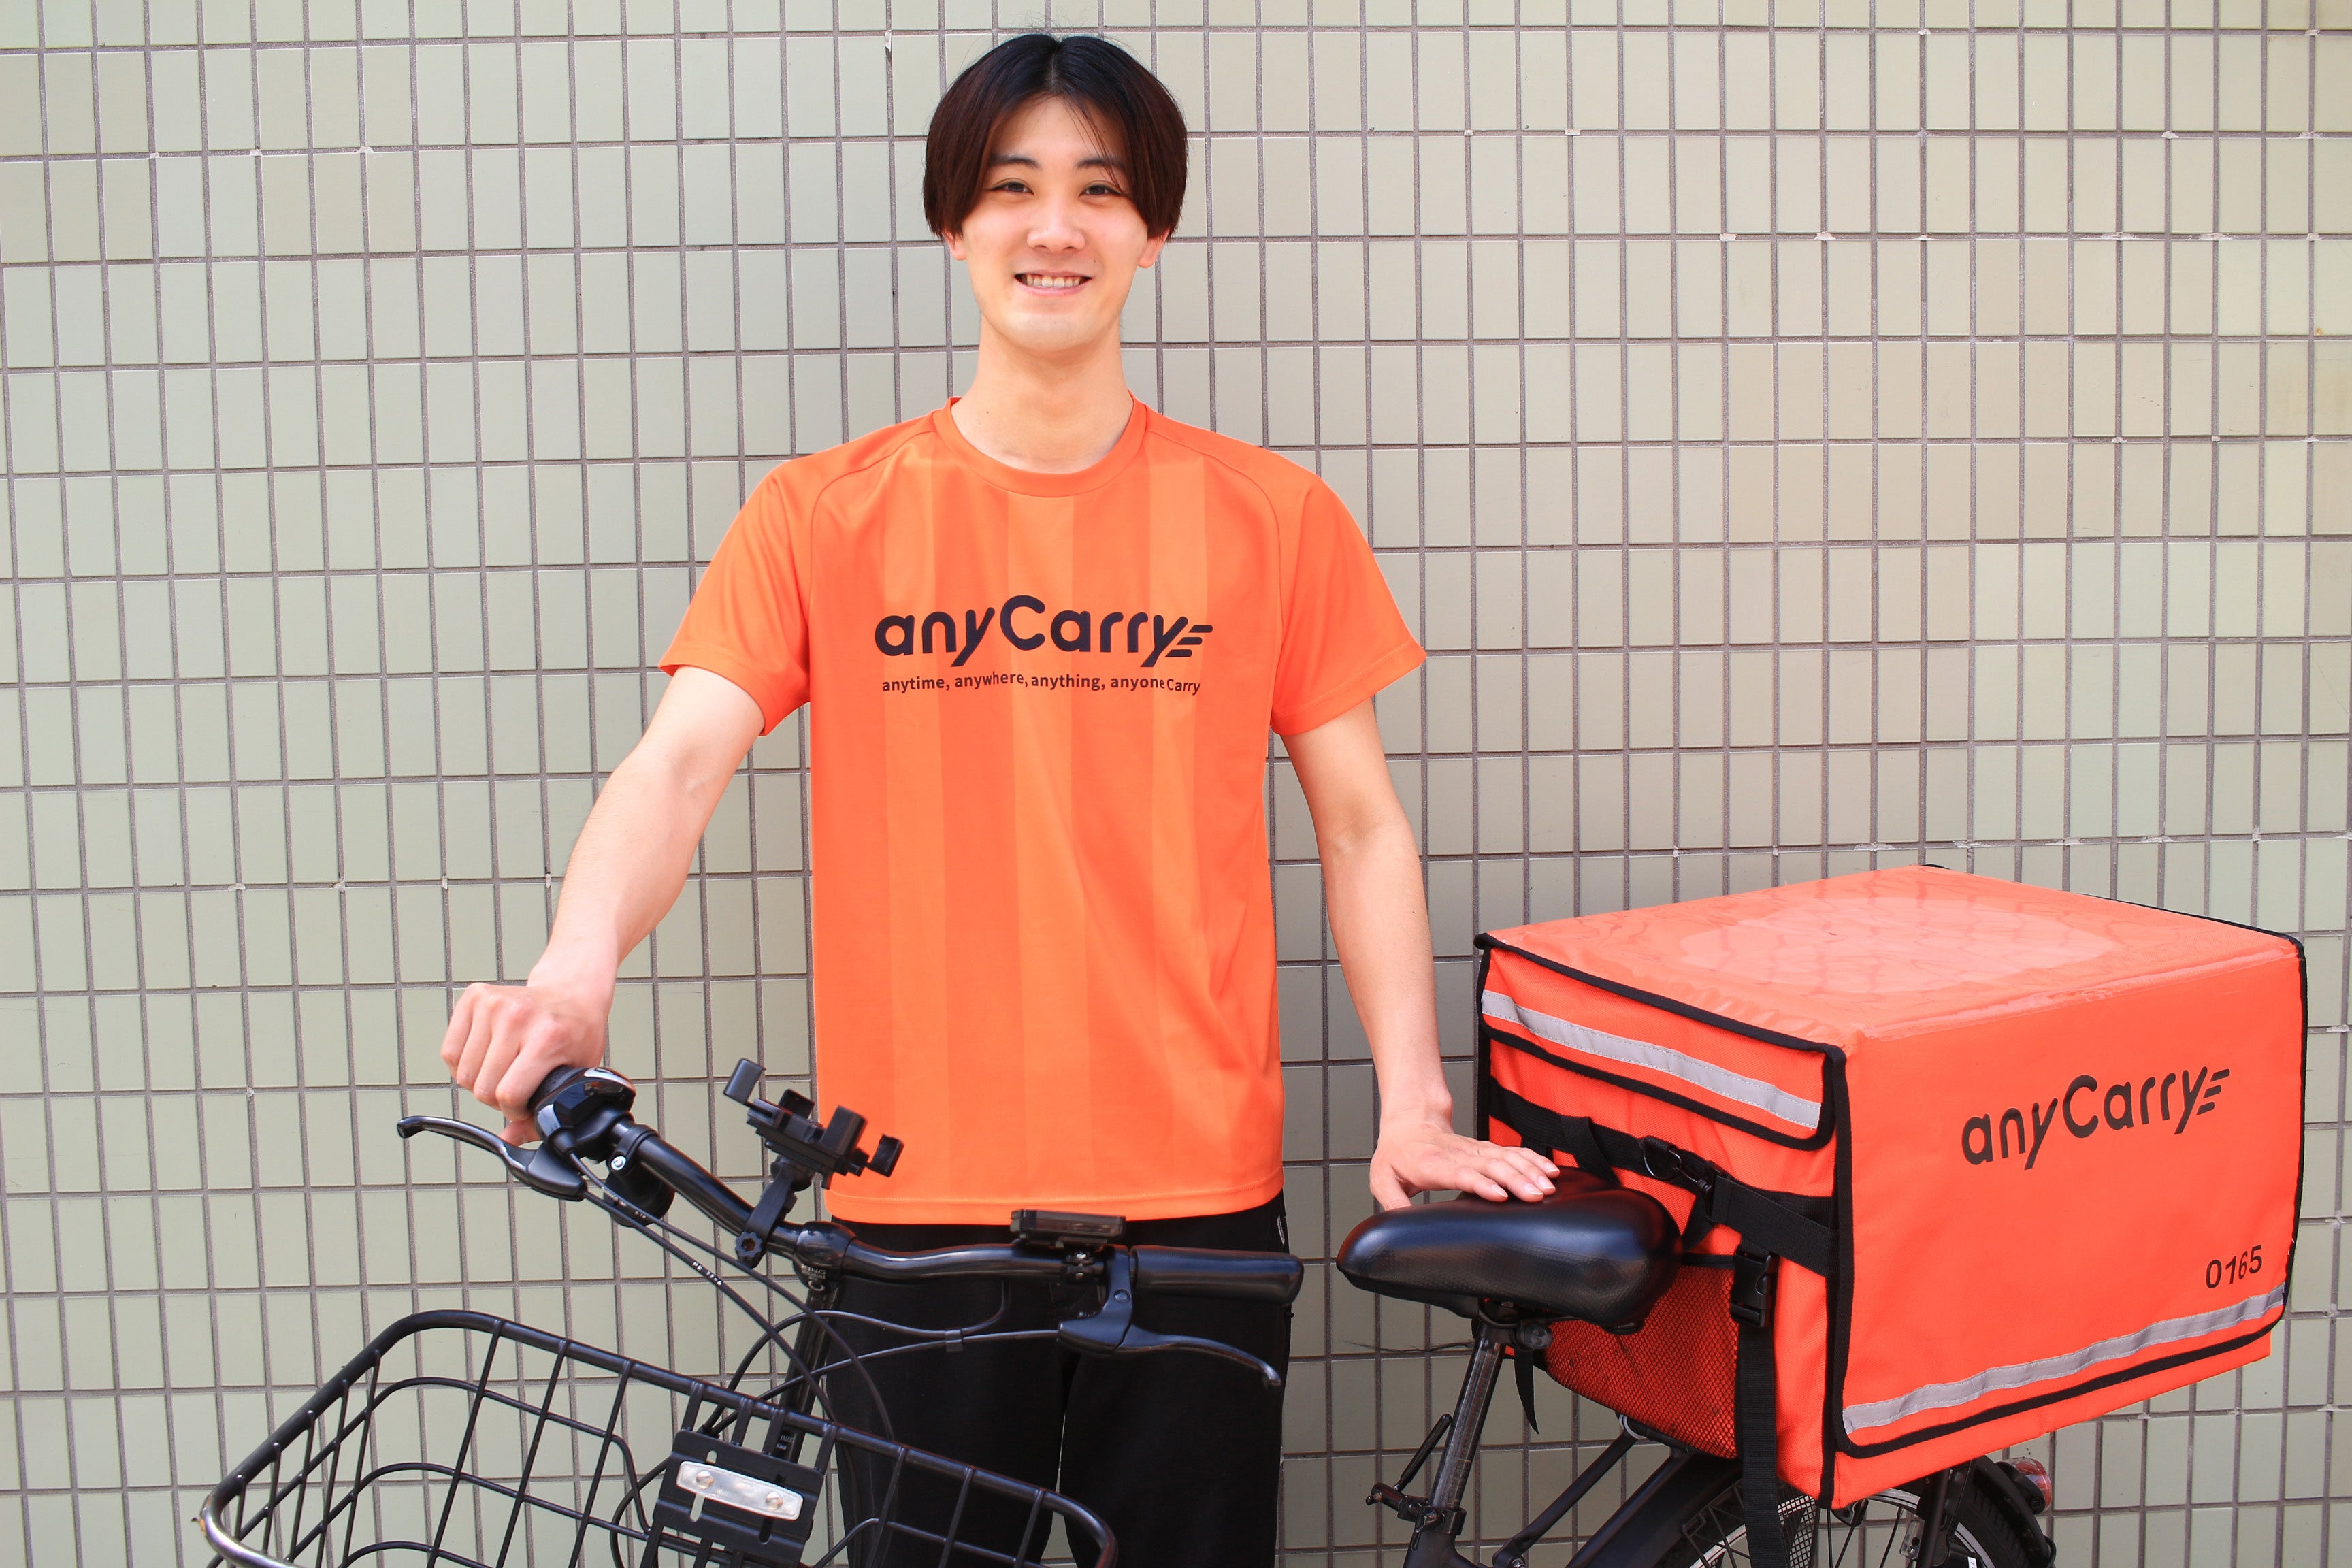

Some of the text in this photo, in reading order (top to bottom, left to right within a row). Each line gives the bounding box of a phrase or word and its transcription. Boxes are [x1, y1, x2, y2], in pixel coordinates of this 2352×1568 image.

[875, 595, 1188, 668] anyCarry
[882, 671, 1201, 696] anytime, anywhere, anything, anyone Carry
[1962, 1066, 2208, 1170] anyCarry
[2206, 1245, 2262, 1289] 0165
